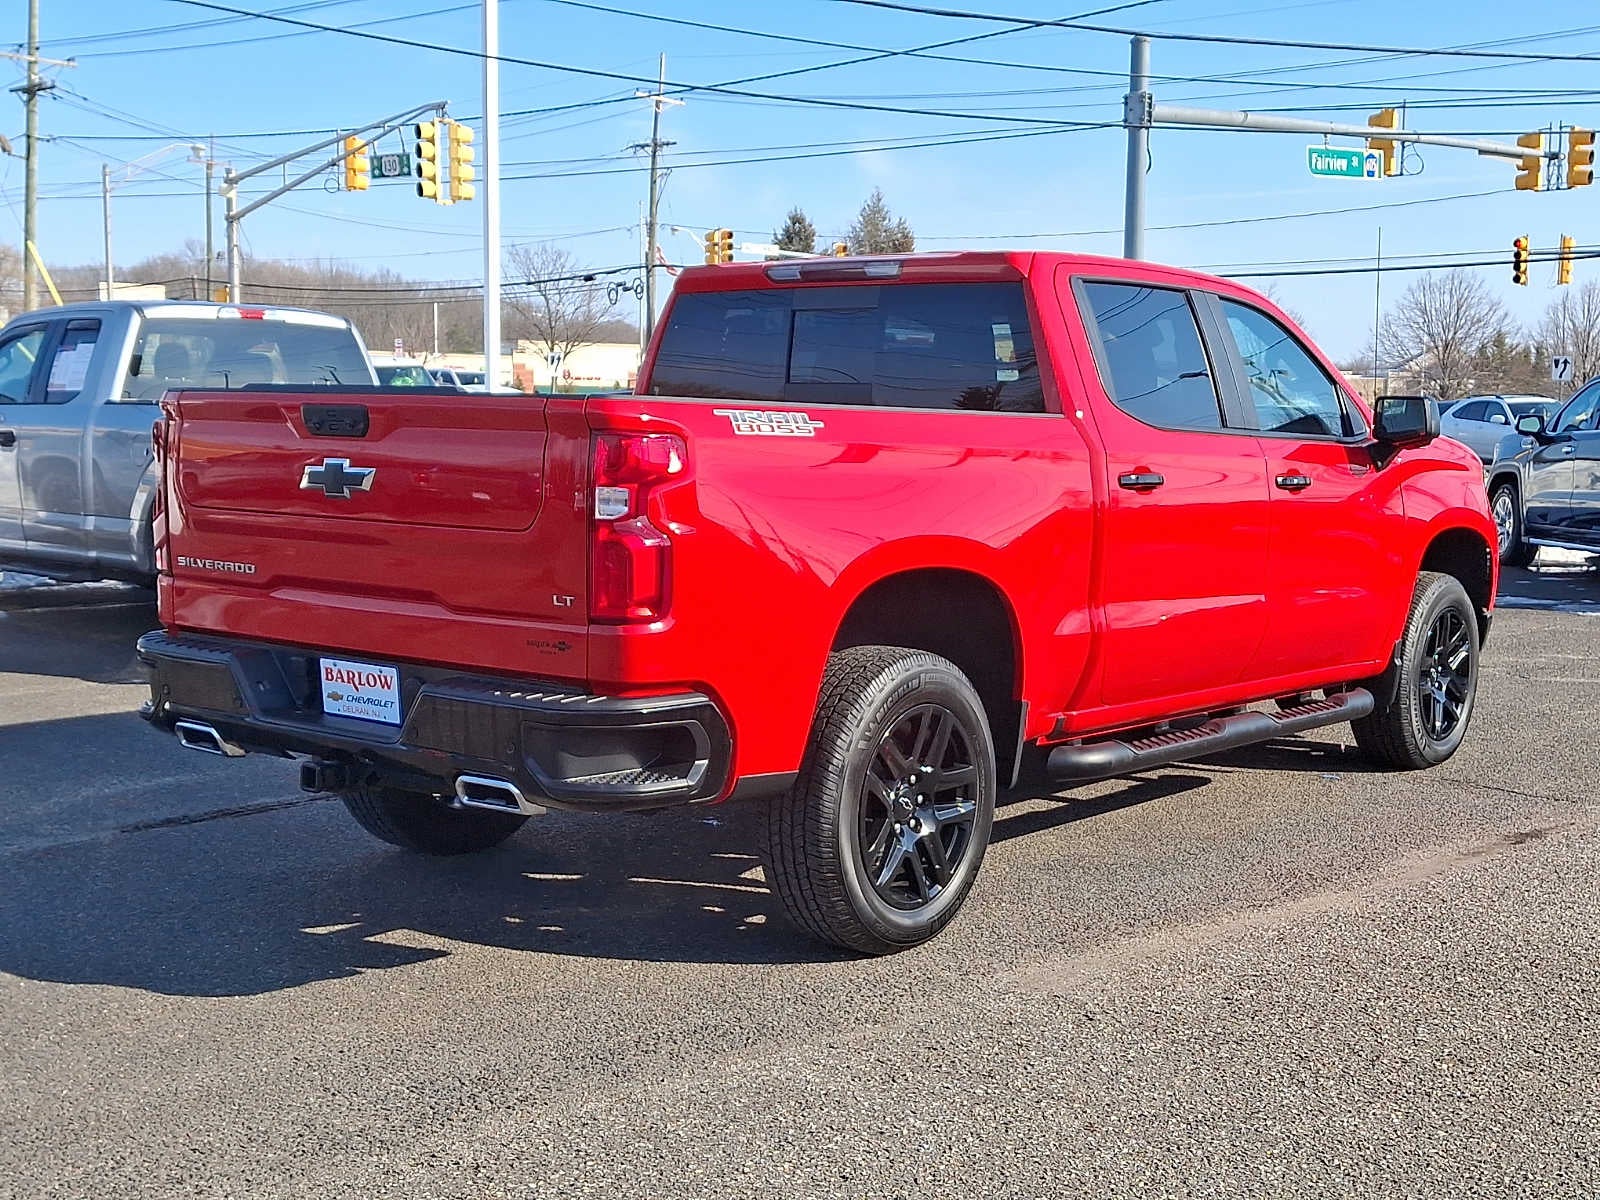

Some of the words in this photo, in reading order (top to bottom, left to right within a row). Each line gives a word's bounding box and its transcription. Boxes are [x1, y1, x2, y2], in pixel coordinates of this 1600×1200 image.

[384, 159, 398, 172] 130
[1311, 152, 1348, 172] Fairview
[713, 408, 824, 426] TRAIL
[734, 422, 815, 436] BOSS
[177, 556, 256, 574] SILVERADO
[552, 595, 575, 606] LT
[324, 667, 393, 692] BARLOW
[346, 694, 395, 708] CHEVROLET
